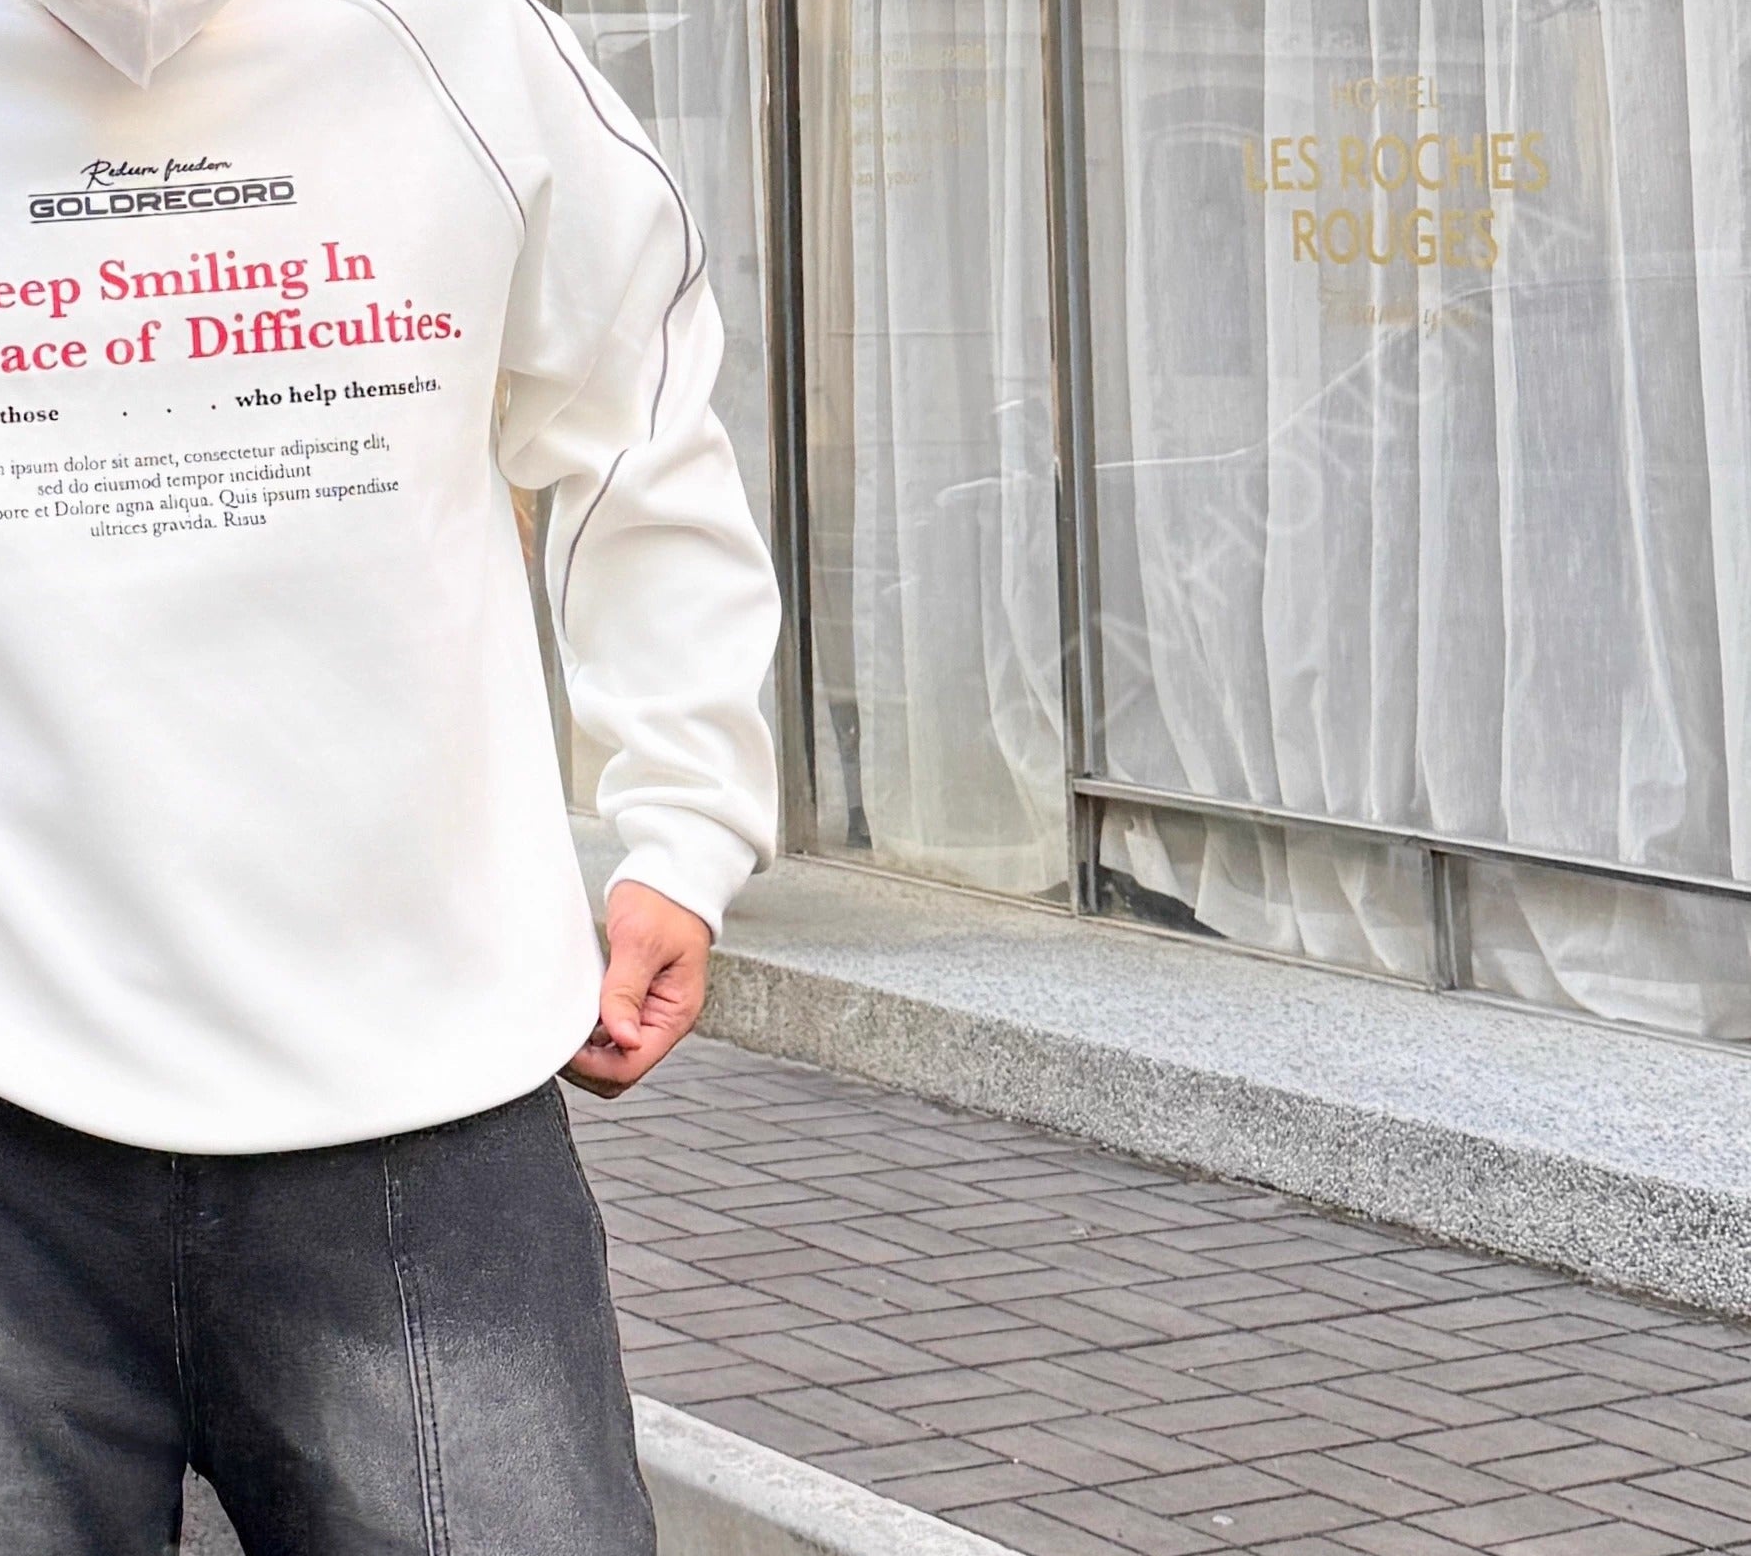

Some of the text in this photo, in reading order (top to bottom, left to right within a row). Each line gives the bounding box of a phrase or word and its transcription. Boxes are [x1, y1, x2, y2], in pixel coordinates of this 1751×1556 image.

[1242, 131, 1550, 192] LES ROCHES
[29, 181, 295, 221] GOLDRECORD
[1292, 208, 1499, 270] ROUGES
[99, 250, 308, 300] Smiling
[321, 241, 376, 284] In
[105, 320, 161, 366] of
[186, 299, 463, 359] Difficulties.
[0, 404, 60, 425] those
[235, 388, 283, 408] who
[288, 383, 338, 408] help
[10, 460, 59, 479] ipsum
[64, 455, 107, 473] dolor
[111, 453, 130, 469] sit
[184, 446, 275, 464] consectetur
[280, 436, 359, 461] adipiscing
[37, 479, 63, 496] sed
[68, 478, 89, 494] do
[167, 470, 225, 490] tempor
[230, 464, 312, 484] incididunt
[34, 504, 50, 518] et
[54, 500, 110, 518] Dolore
[219, 489, 258, 509] Quis
[262, 486, 311, 507] ipsum
[90, 520, 148, 538] ultrices
